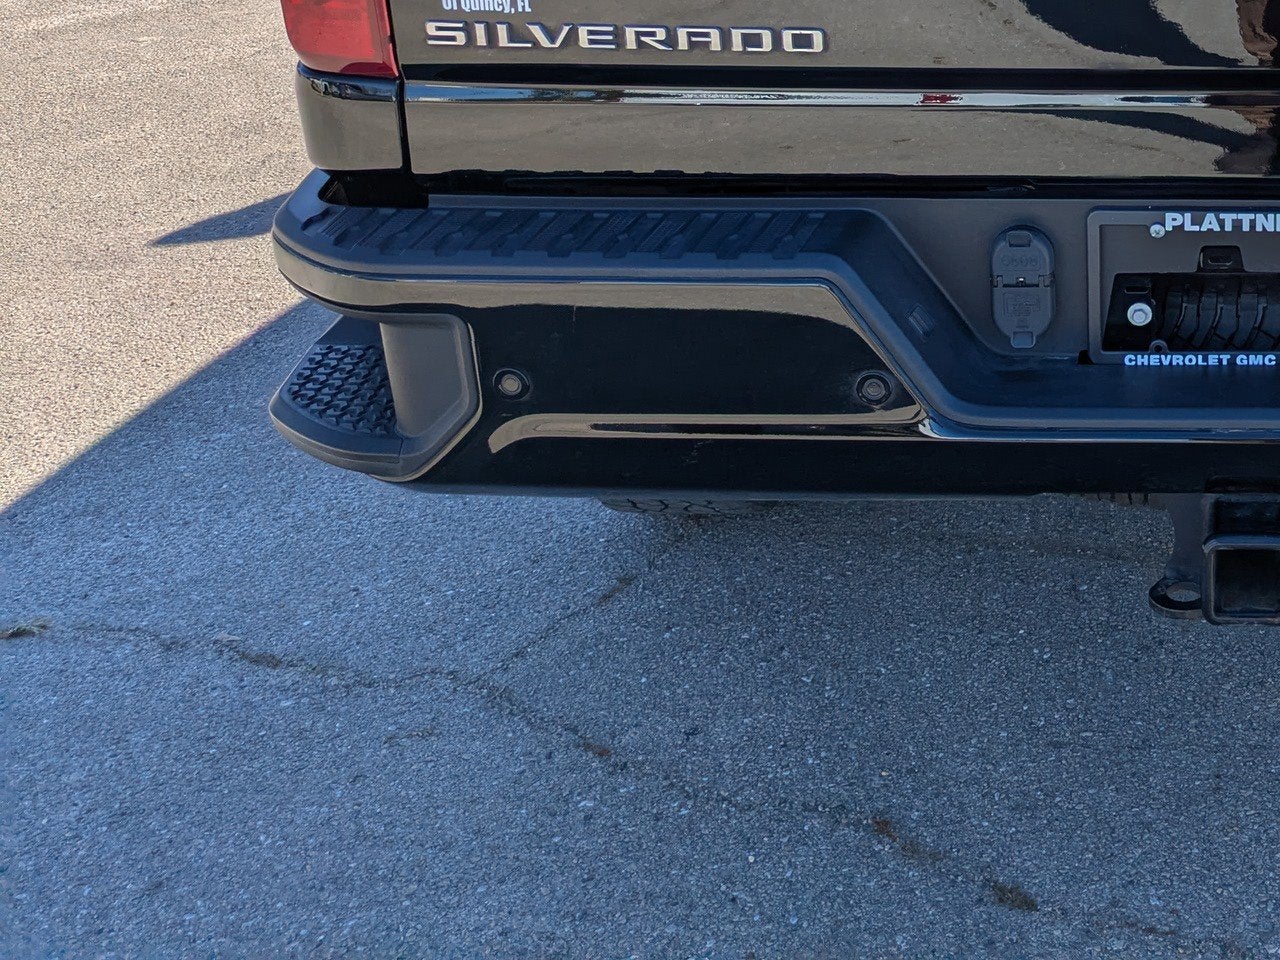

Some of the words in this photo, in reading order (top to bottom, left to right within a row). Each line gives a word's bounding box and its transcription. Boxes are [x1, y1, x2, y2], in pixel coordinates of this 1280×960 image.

[424, 19, 829, 54] SILVERADO
[1124, 354, 1231, 366] CHEVROLET
[1236, 354, 1276, 366] GMC
